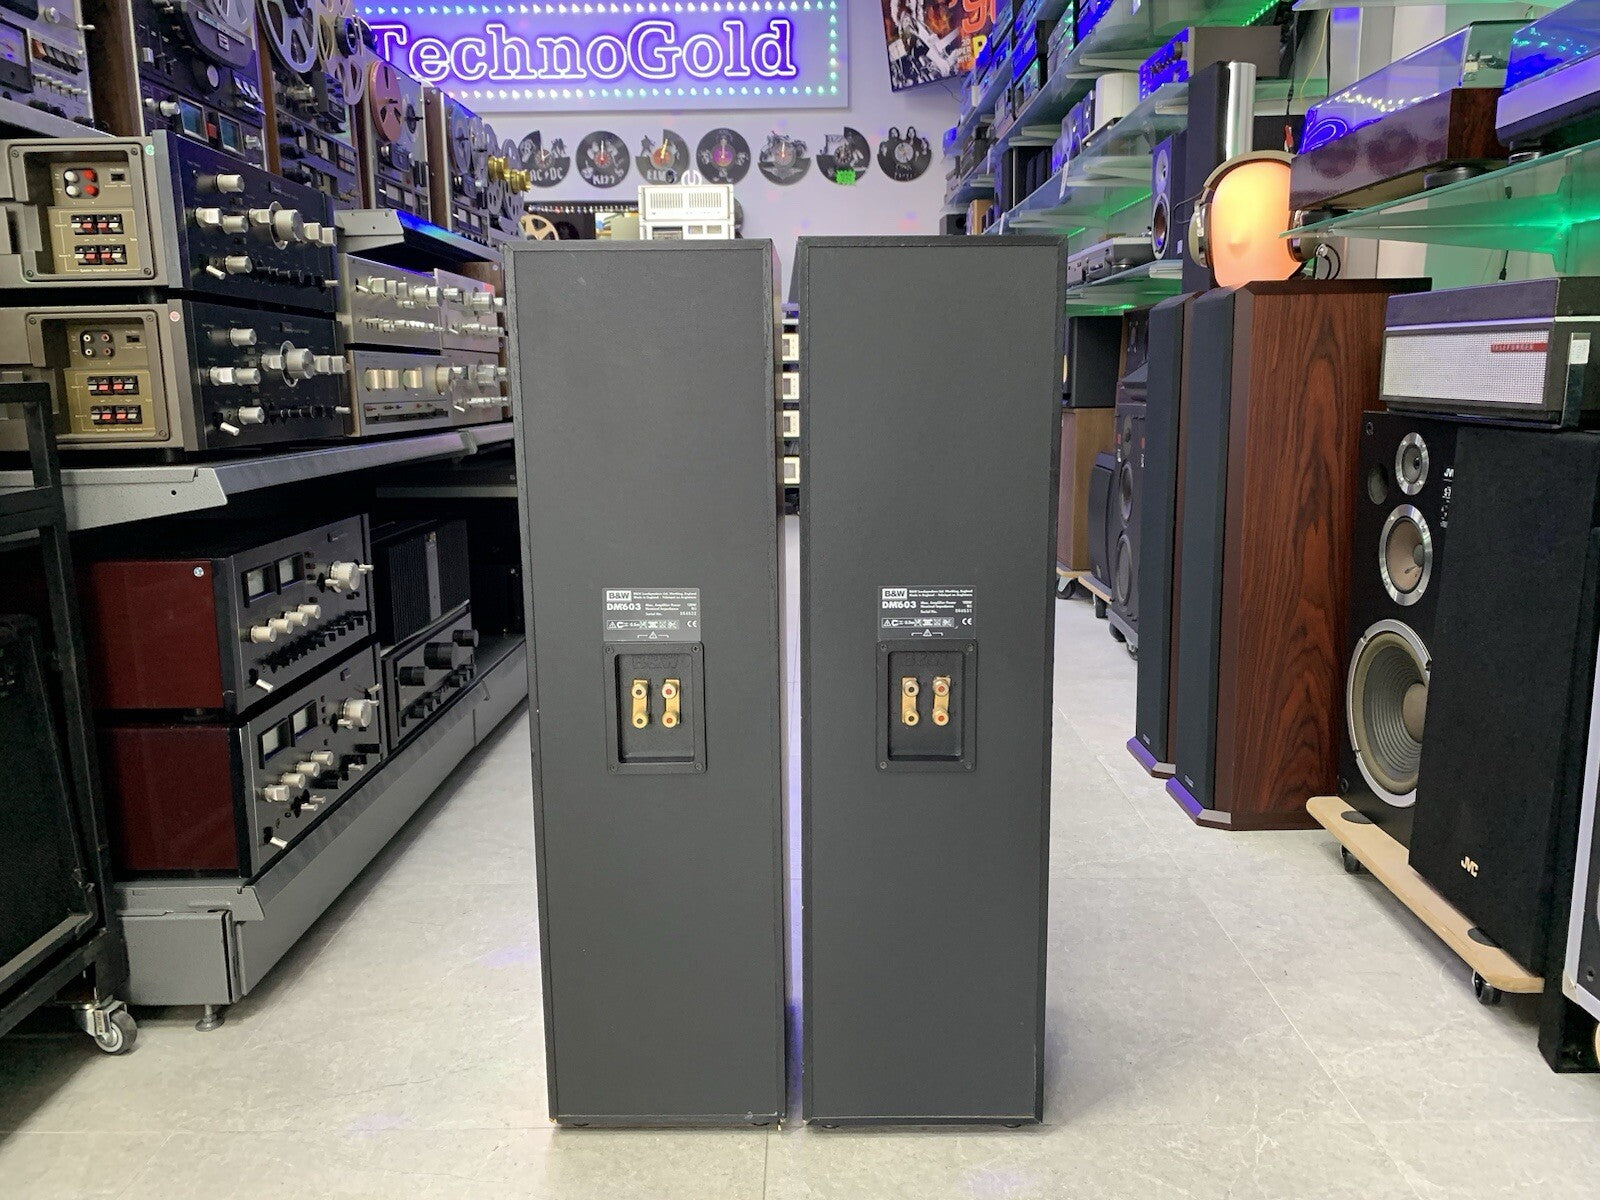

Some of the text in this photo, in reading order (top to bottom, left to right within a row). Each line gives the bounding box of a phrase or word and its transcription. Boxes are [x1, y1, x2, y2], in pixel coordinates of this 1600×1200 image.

[369, 19, 798, 81] TechnoGold
[608, 592, 630, 600] B&W
[884, 590, 906, 598] B&W
[606, 603, 642, 611] DM603
[882, 601, 917, 609] DM603
[1460, 856, 1479, 877] JVC
